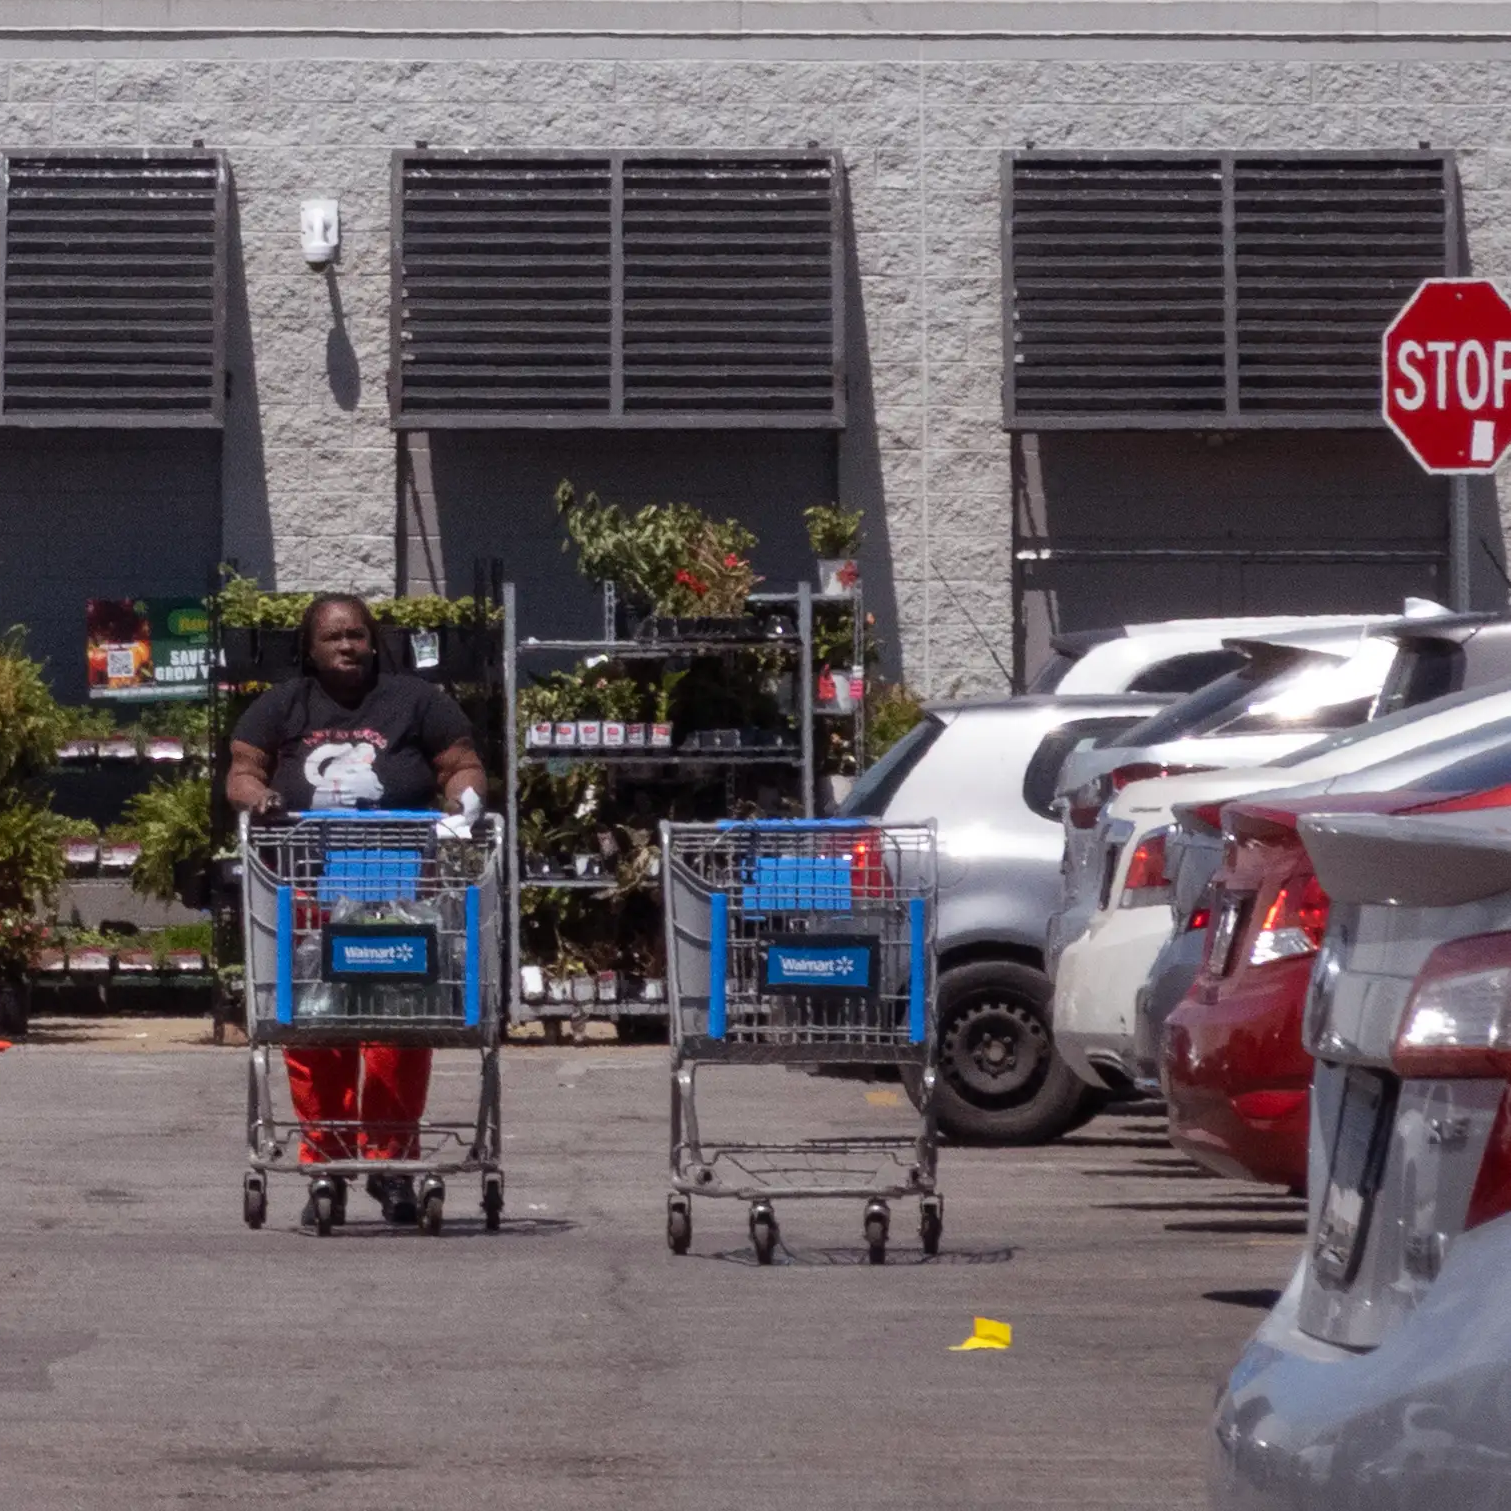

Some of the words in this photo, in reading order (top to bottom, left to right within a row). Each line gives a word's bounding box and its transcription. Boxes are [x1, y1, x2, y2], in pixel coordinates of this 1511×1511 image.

[170, 649, 206, 666] SAVE
[155, 666, 198, 681] GROW
[344, 946, 395, 959] Walmart
[778, 954, 834, 971] Walmart
